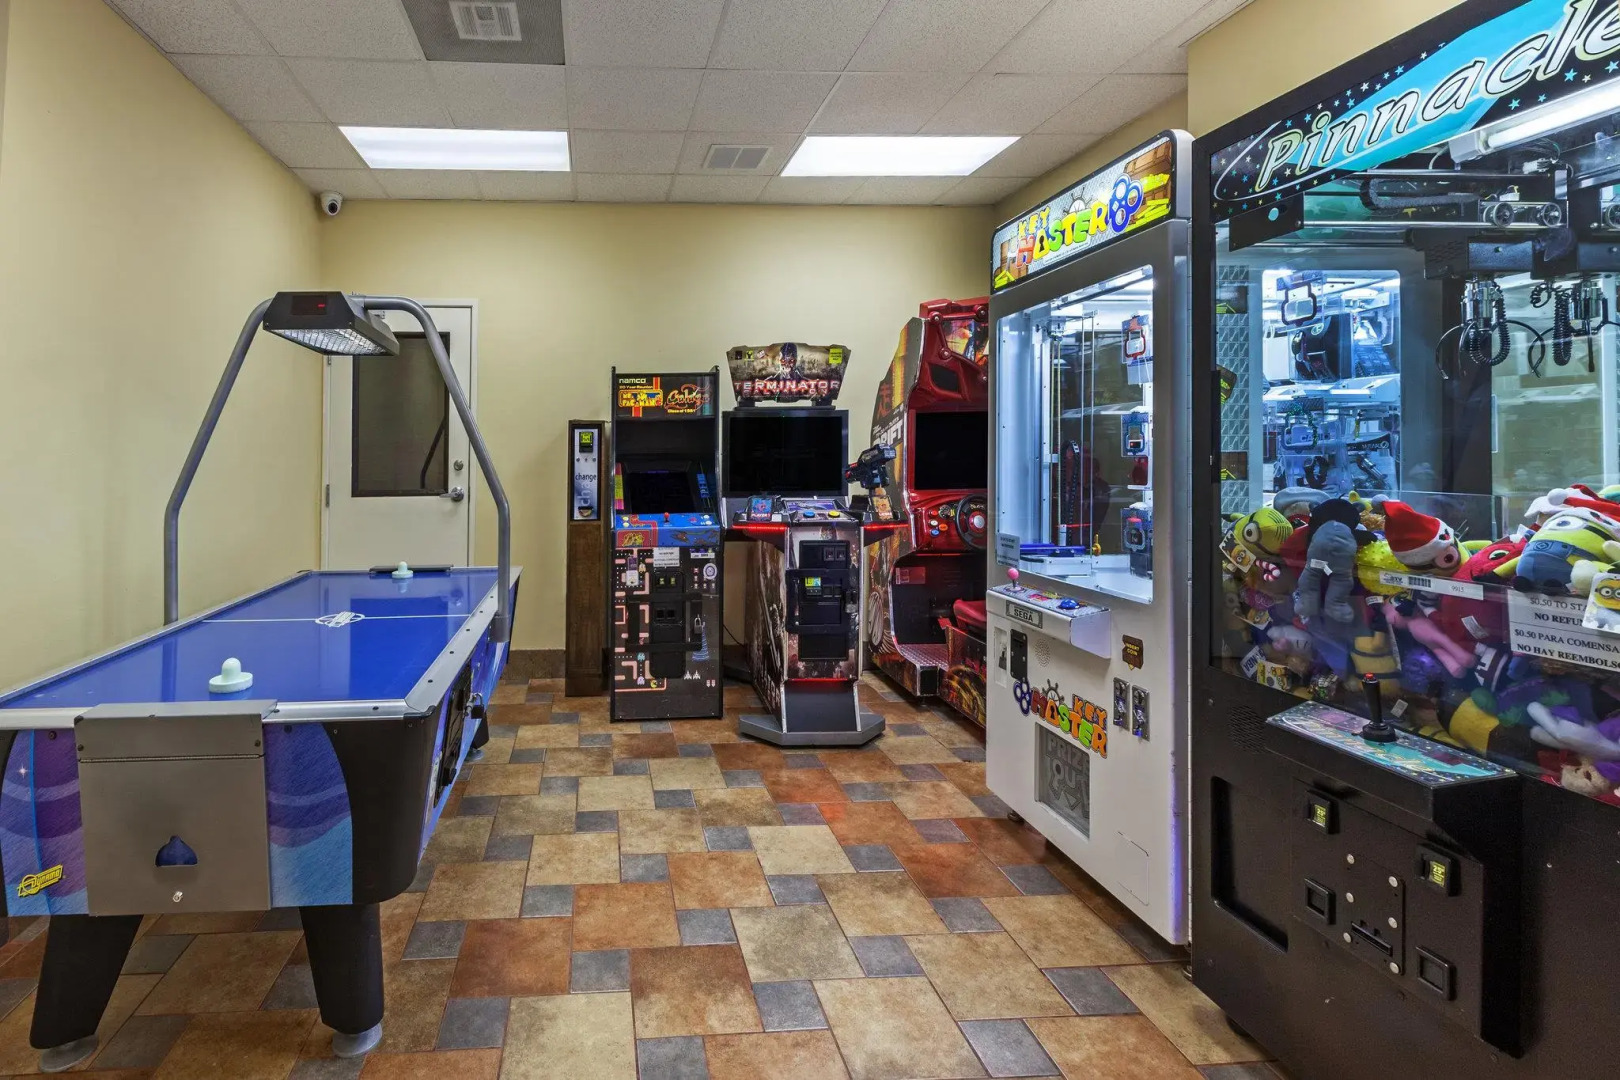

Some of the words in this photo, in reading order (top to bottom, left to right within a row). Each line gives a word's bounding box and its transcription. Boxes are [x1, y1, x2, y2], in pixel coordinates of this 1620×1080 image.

[1254, 0, 1620, 192] Pinnacle
[1018, 206, 1051, 240] KEY
[1016, 201, 1108, 268] MASTER
[734, 380, 840, 390] TERMINATOR
[575, 473, 597, 482] change
[1530, 597, 1552, 607] $0.50
[1555, 600, 1568, 609] TO
[1570, 602, 1587, 611] STA
[1014, 608, 1033, 622] SEGA
[1534, 612, 1549, 621] NO
[1551, 614, 1583, 626] REFUN
[1515, 628, 1536, 639] $0.50
[1538, 632, 1564, 643] PARA
[1566, 637, 1620, 653] COMENSA
[1517, 643, 1531, 652] NO
[1533, 646, 1555, 656] HAY
[1030, 686, 1108, 759] MASTER
[1073, 696, 1108, 730] KEY
